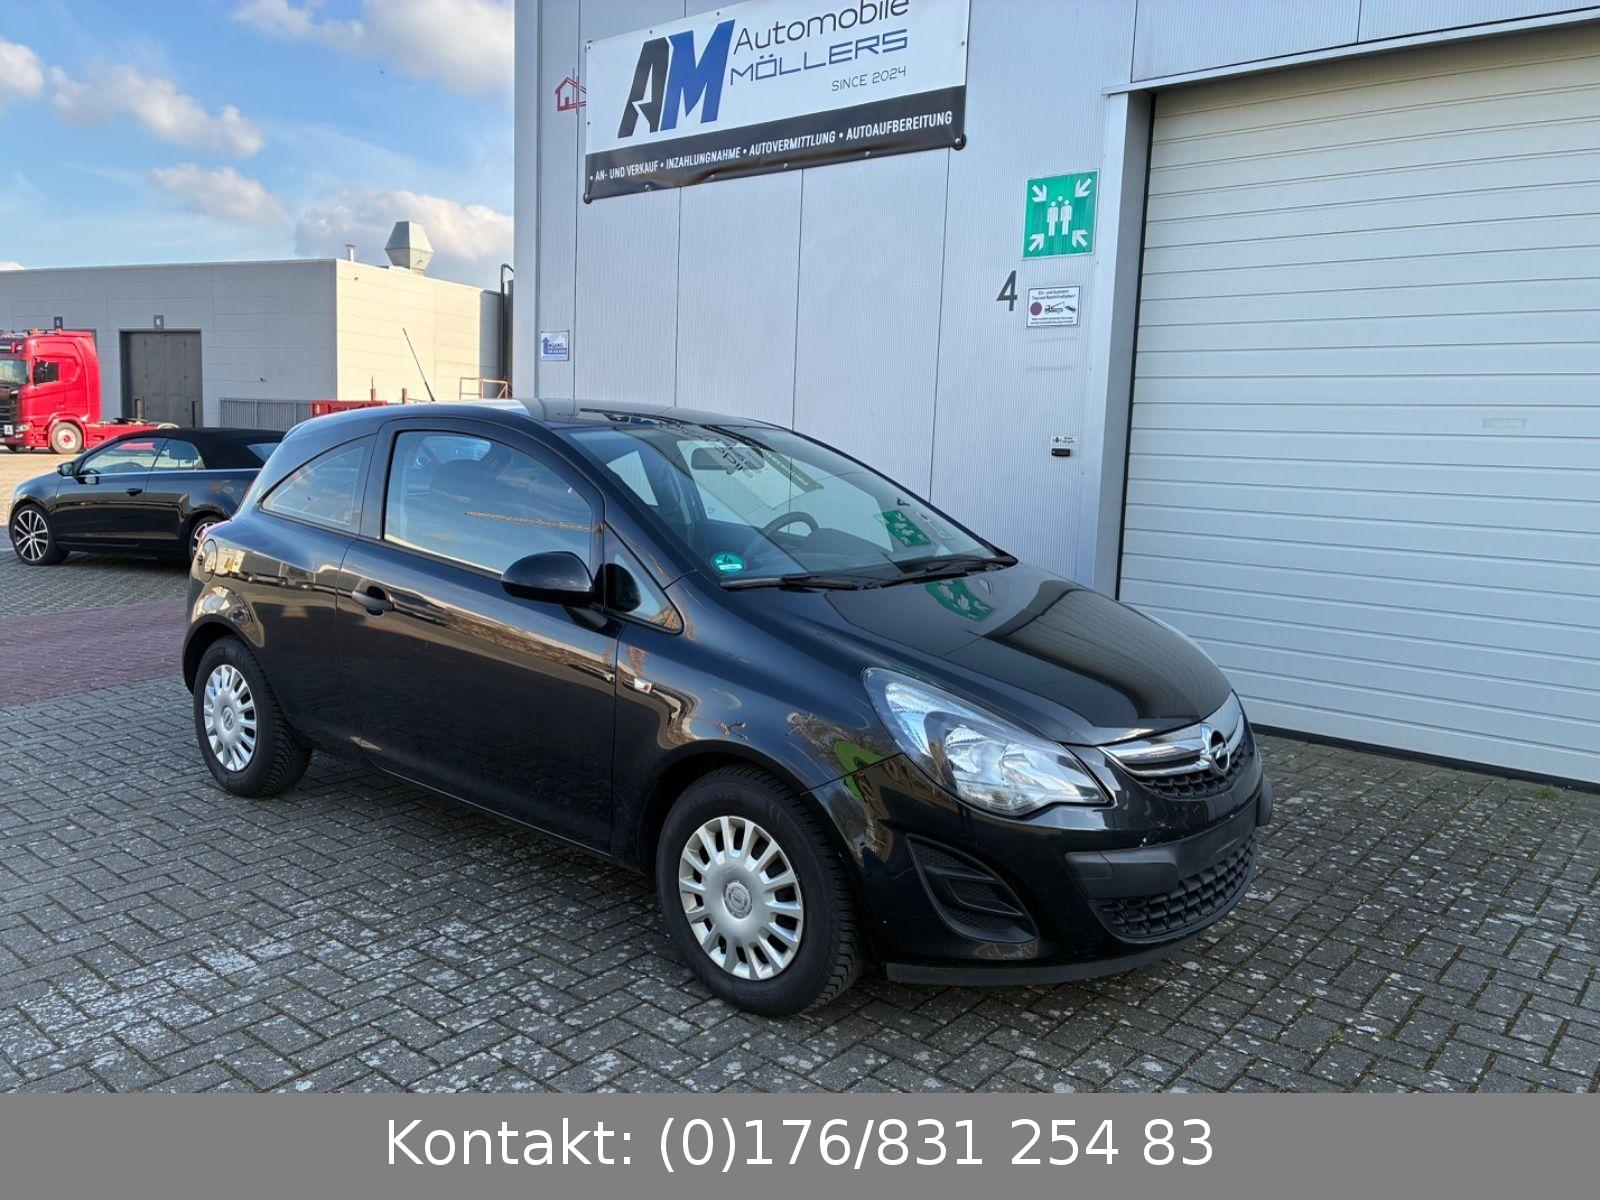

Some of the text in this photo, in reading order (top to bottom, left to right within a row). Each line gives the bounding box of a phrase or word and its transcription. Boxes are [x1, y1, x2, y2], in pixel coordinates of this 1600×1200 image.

[733, 0, 910, 55] Automobile
[617, 18, 736, 139] AM
[730, 28, 908, 86] MÖLLERS
[831, 65, 907, 92] SINCE 2024
[594, 110, 953, 182] AN- UND VERKAUF INZAHLUNGNAHME AUTOVERMITTLUNG AUTOAUFBEREITUNG
[995, 269, 1018, 311] 4
